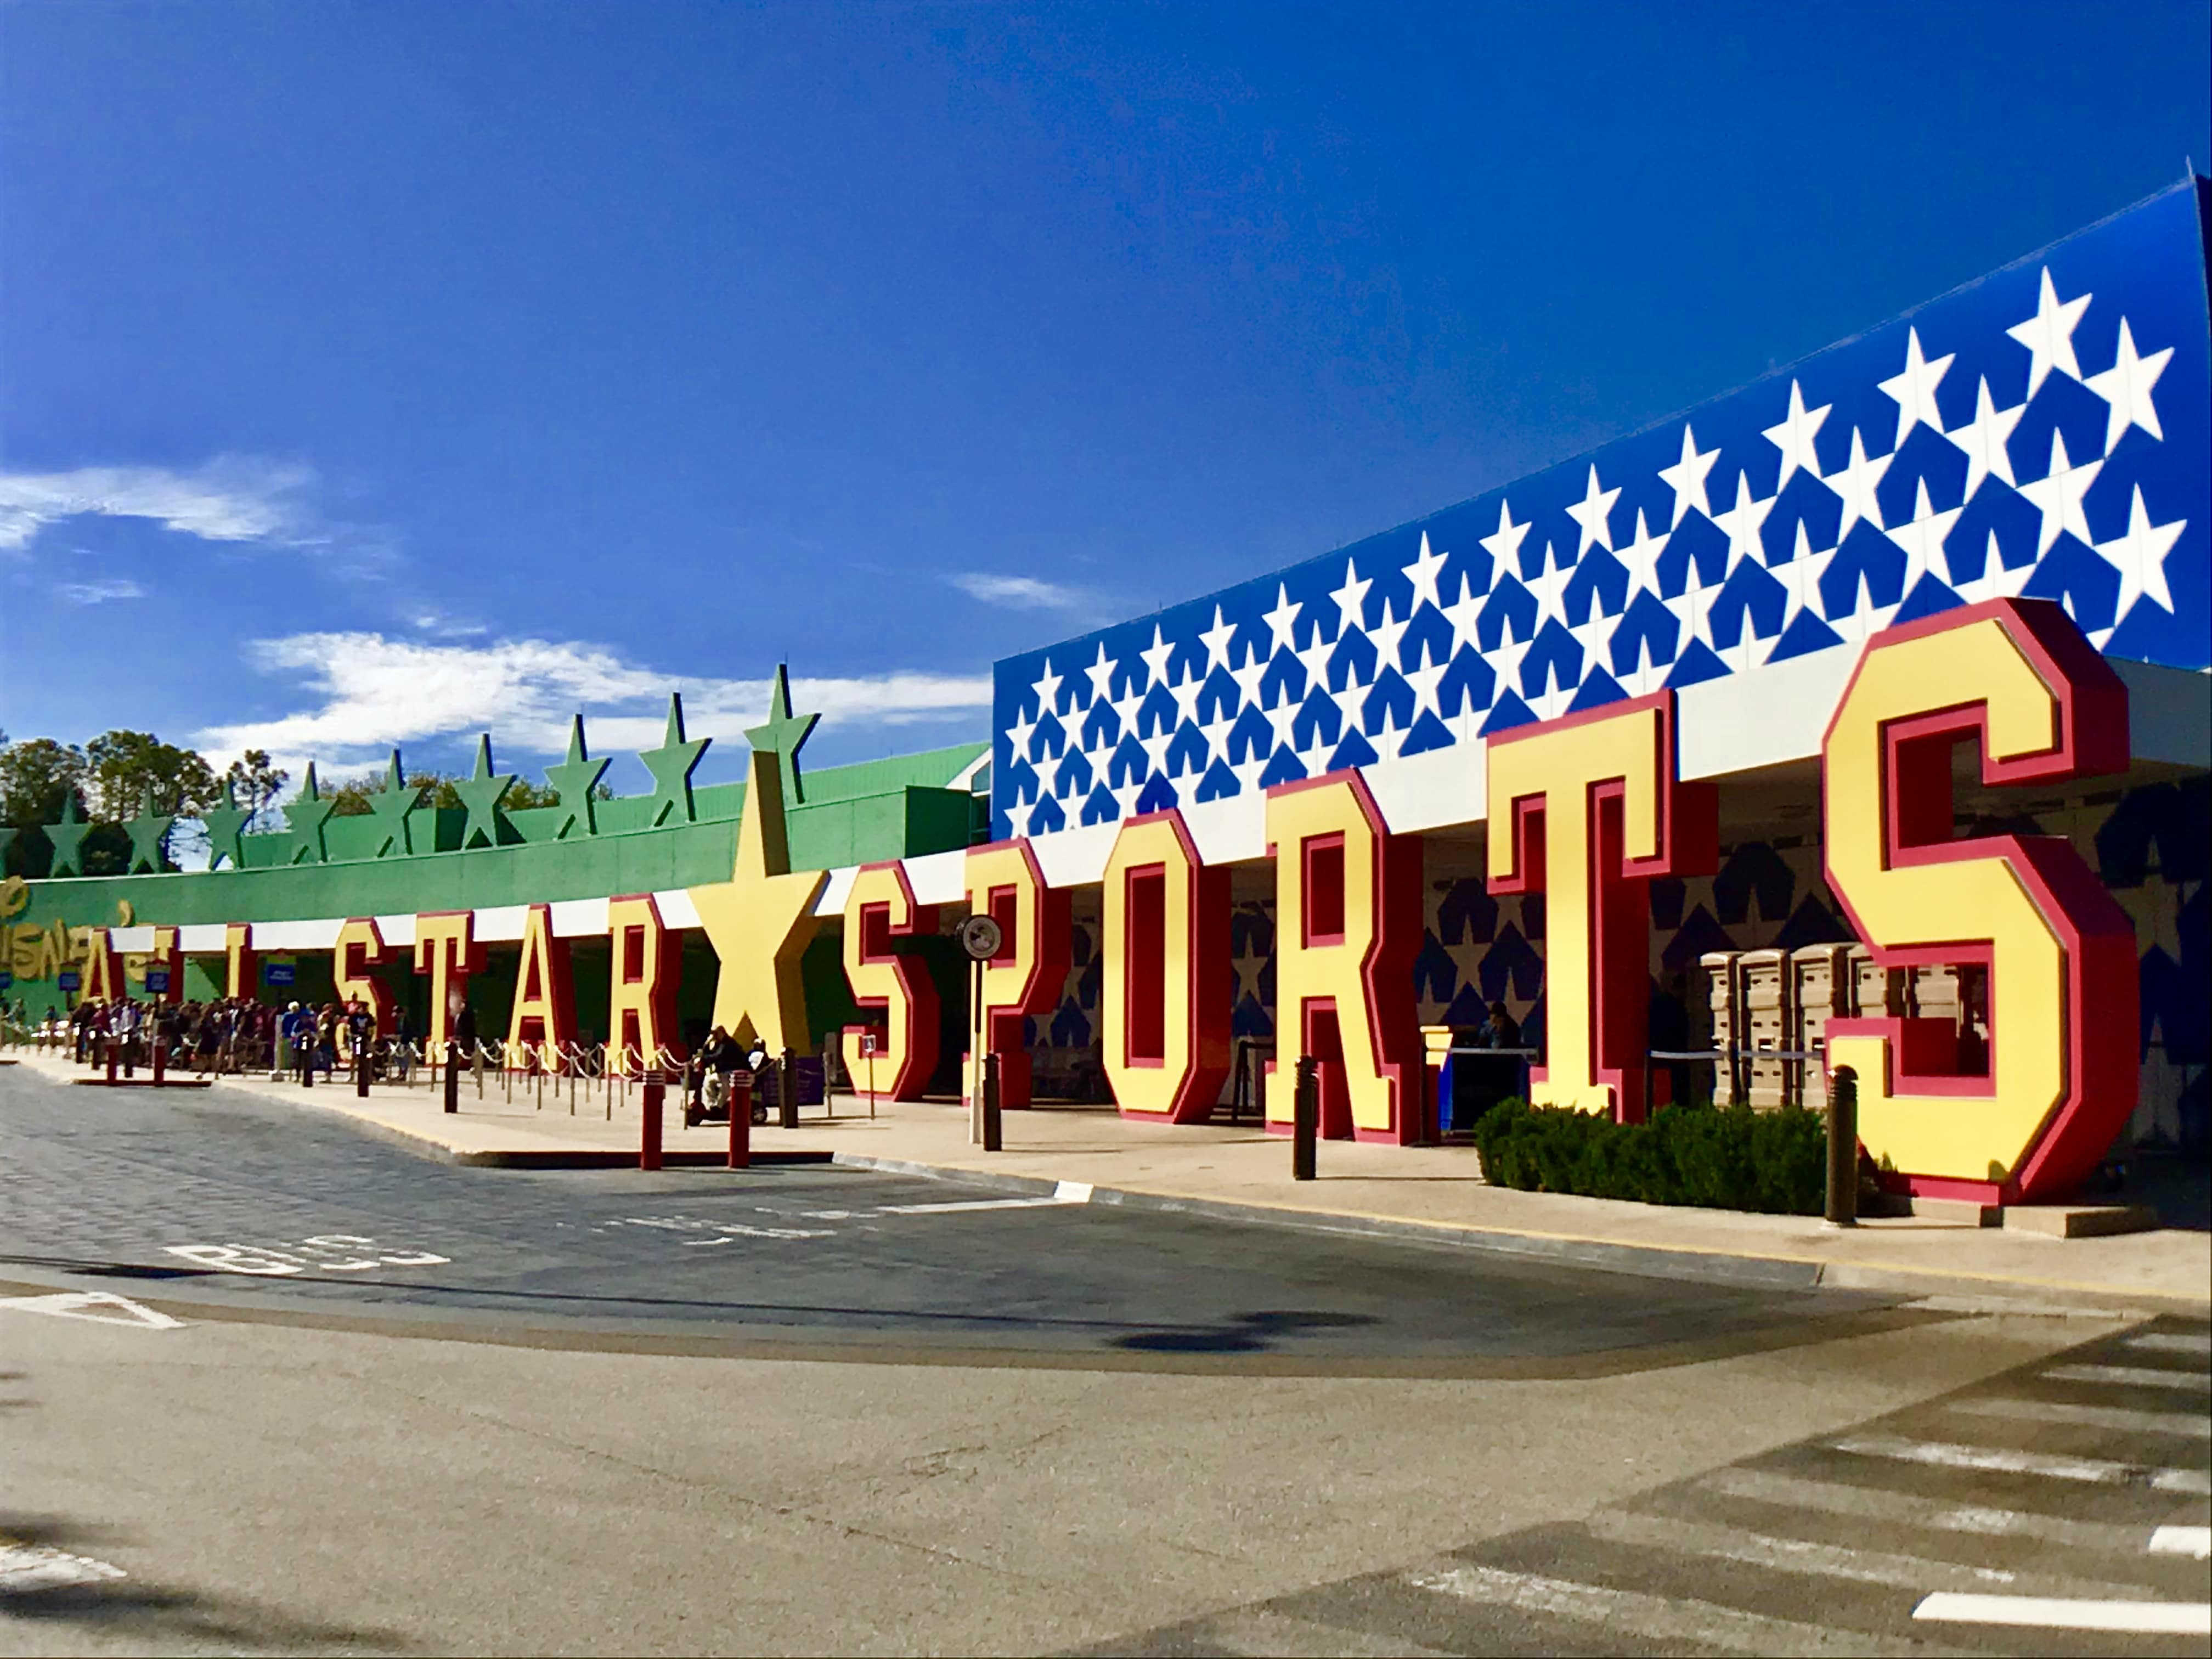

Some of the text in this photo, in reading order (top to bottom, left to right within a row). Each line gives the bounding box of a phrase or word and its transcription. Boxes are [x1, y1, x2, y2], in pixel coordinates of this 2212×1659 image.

[333, 893, 665, 1079] STAR
[842, 596, 2083, 1205] SPORTS
[161, 1234, 451, 1275] BUS
